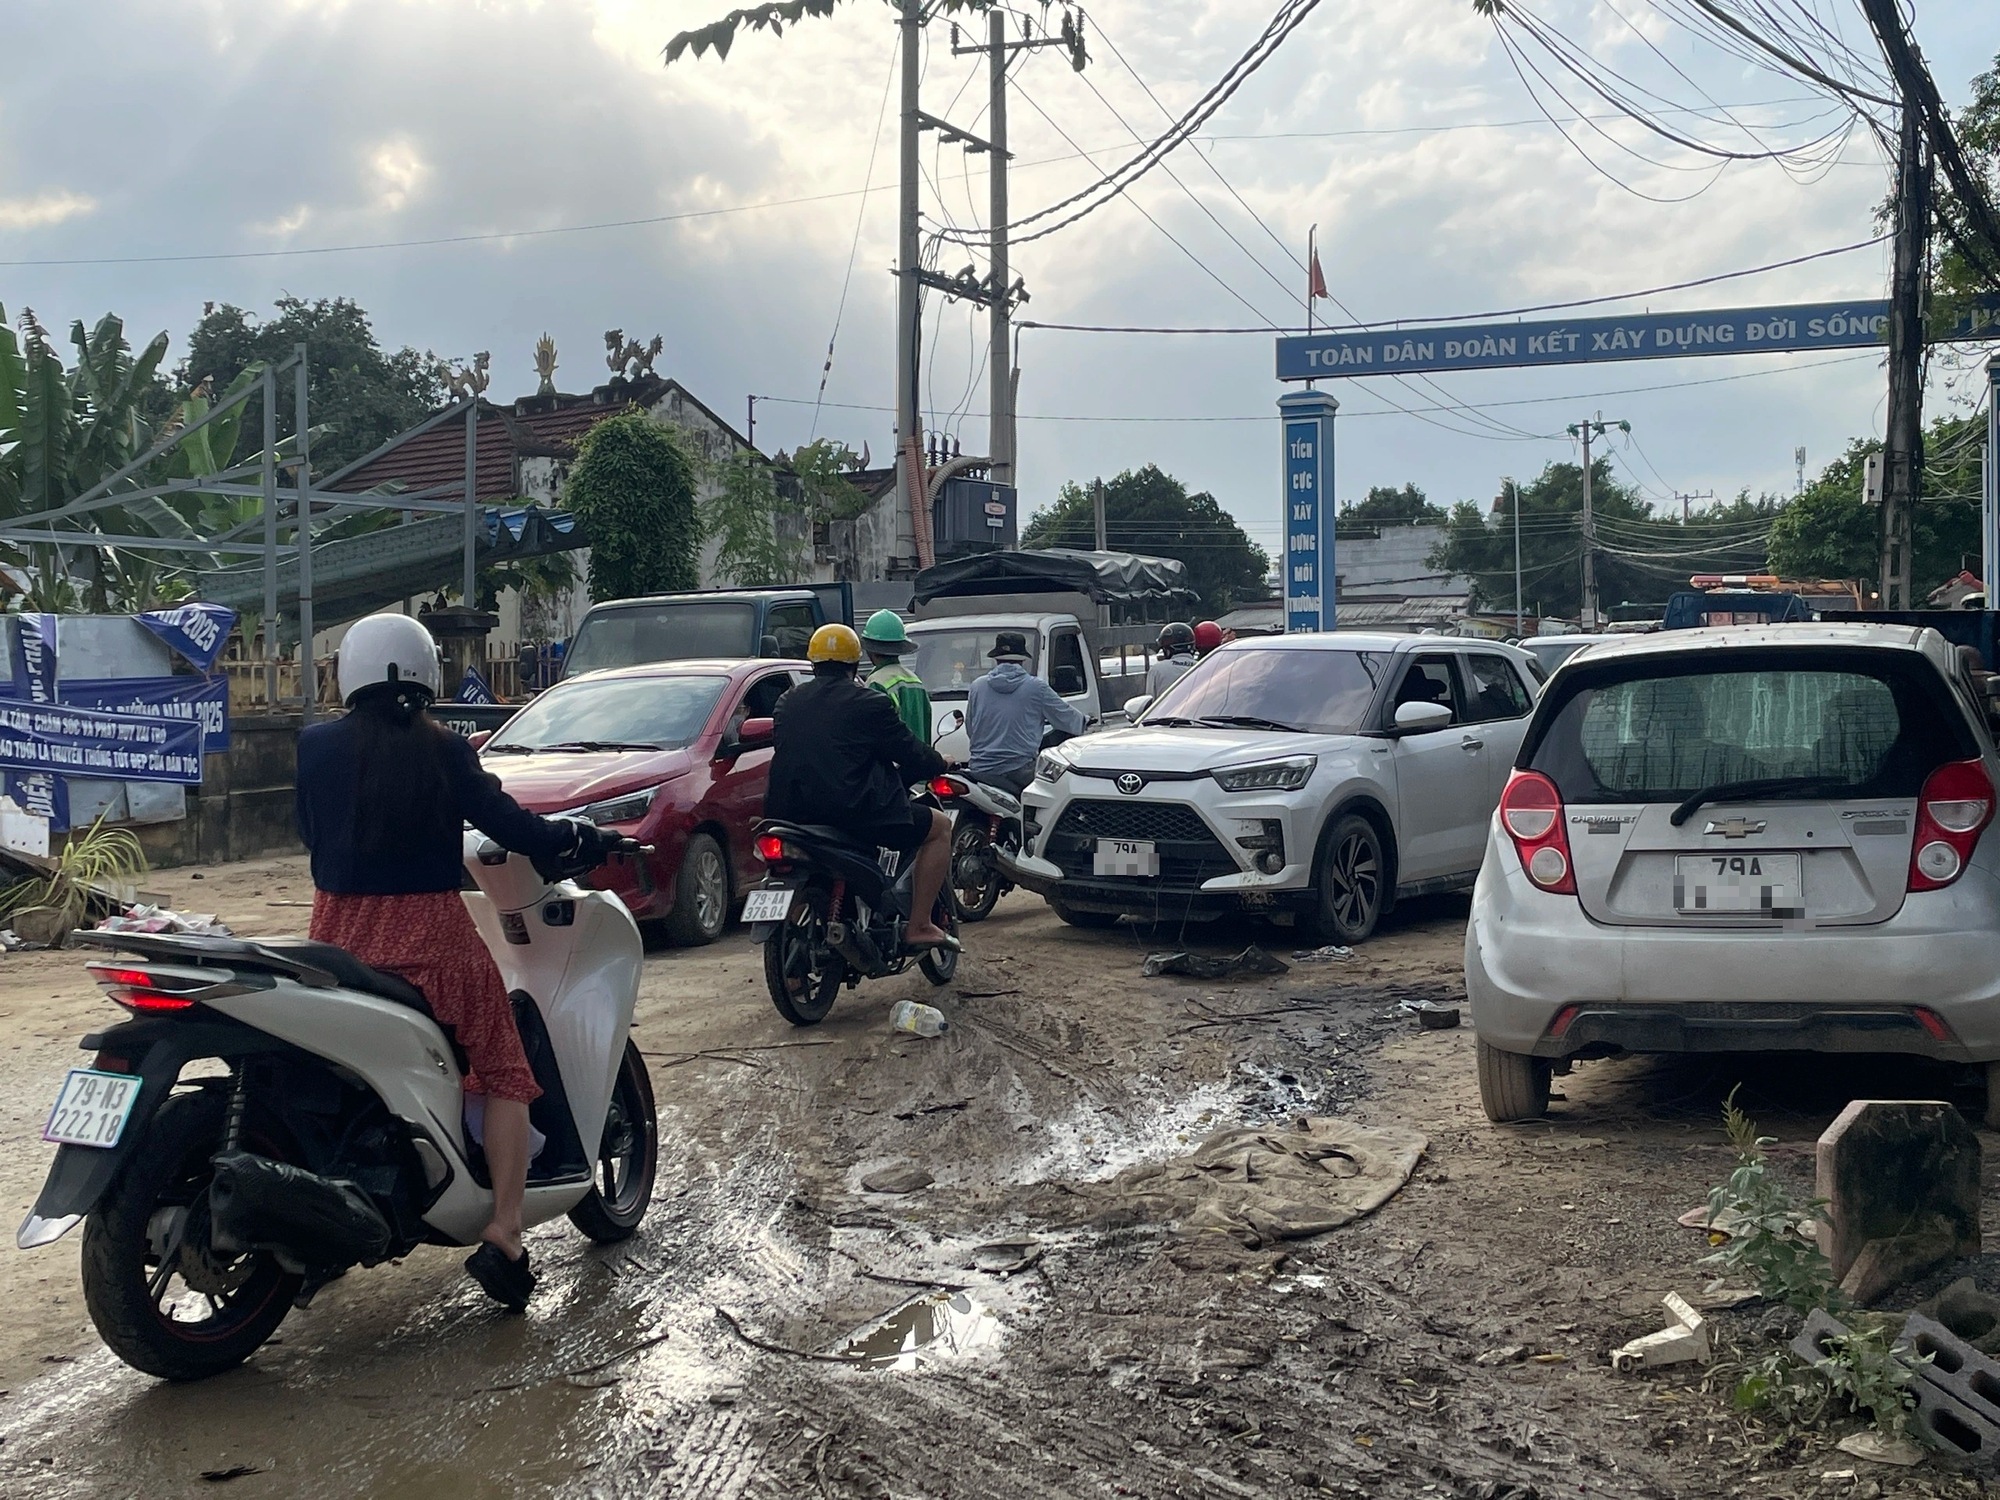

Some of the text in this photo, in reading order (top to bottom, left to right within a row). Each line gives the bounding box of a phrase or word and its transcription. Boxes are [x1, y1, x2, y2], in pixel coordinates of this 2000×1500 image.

[1305, 309, 1889, 367] TOÀN DÂN ĐOÀN KẾT XÂY DỰNG ĐỜI SỐNG
[1290, 437, 1313, 459] TÍCH
[1292, 470, 1313, 493] CỰC
[1293, 501, 1312, 521] XÂY
[1290, 532, 1316, 554] DỰNG
[181, 609, 220, 652] 2025
[195, 701, 223, 733] 2025
[38, 739, 50, 761] LÀ
[113, 747, 129, 769] TỐT
[1571, 815, 1637, 824] CHEVROLET
[1114, 842, 1137, 854] 79A
[1711, 857, 1762, 875] 79A
[745, 905, 784, 919] 376.04
[70, 1077, 128, 1110] 79-N3
[50, 1108, 122, 1142] 222.18
